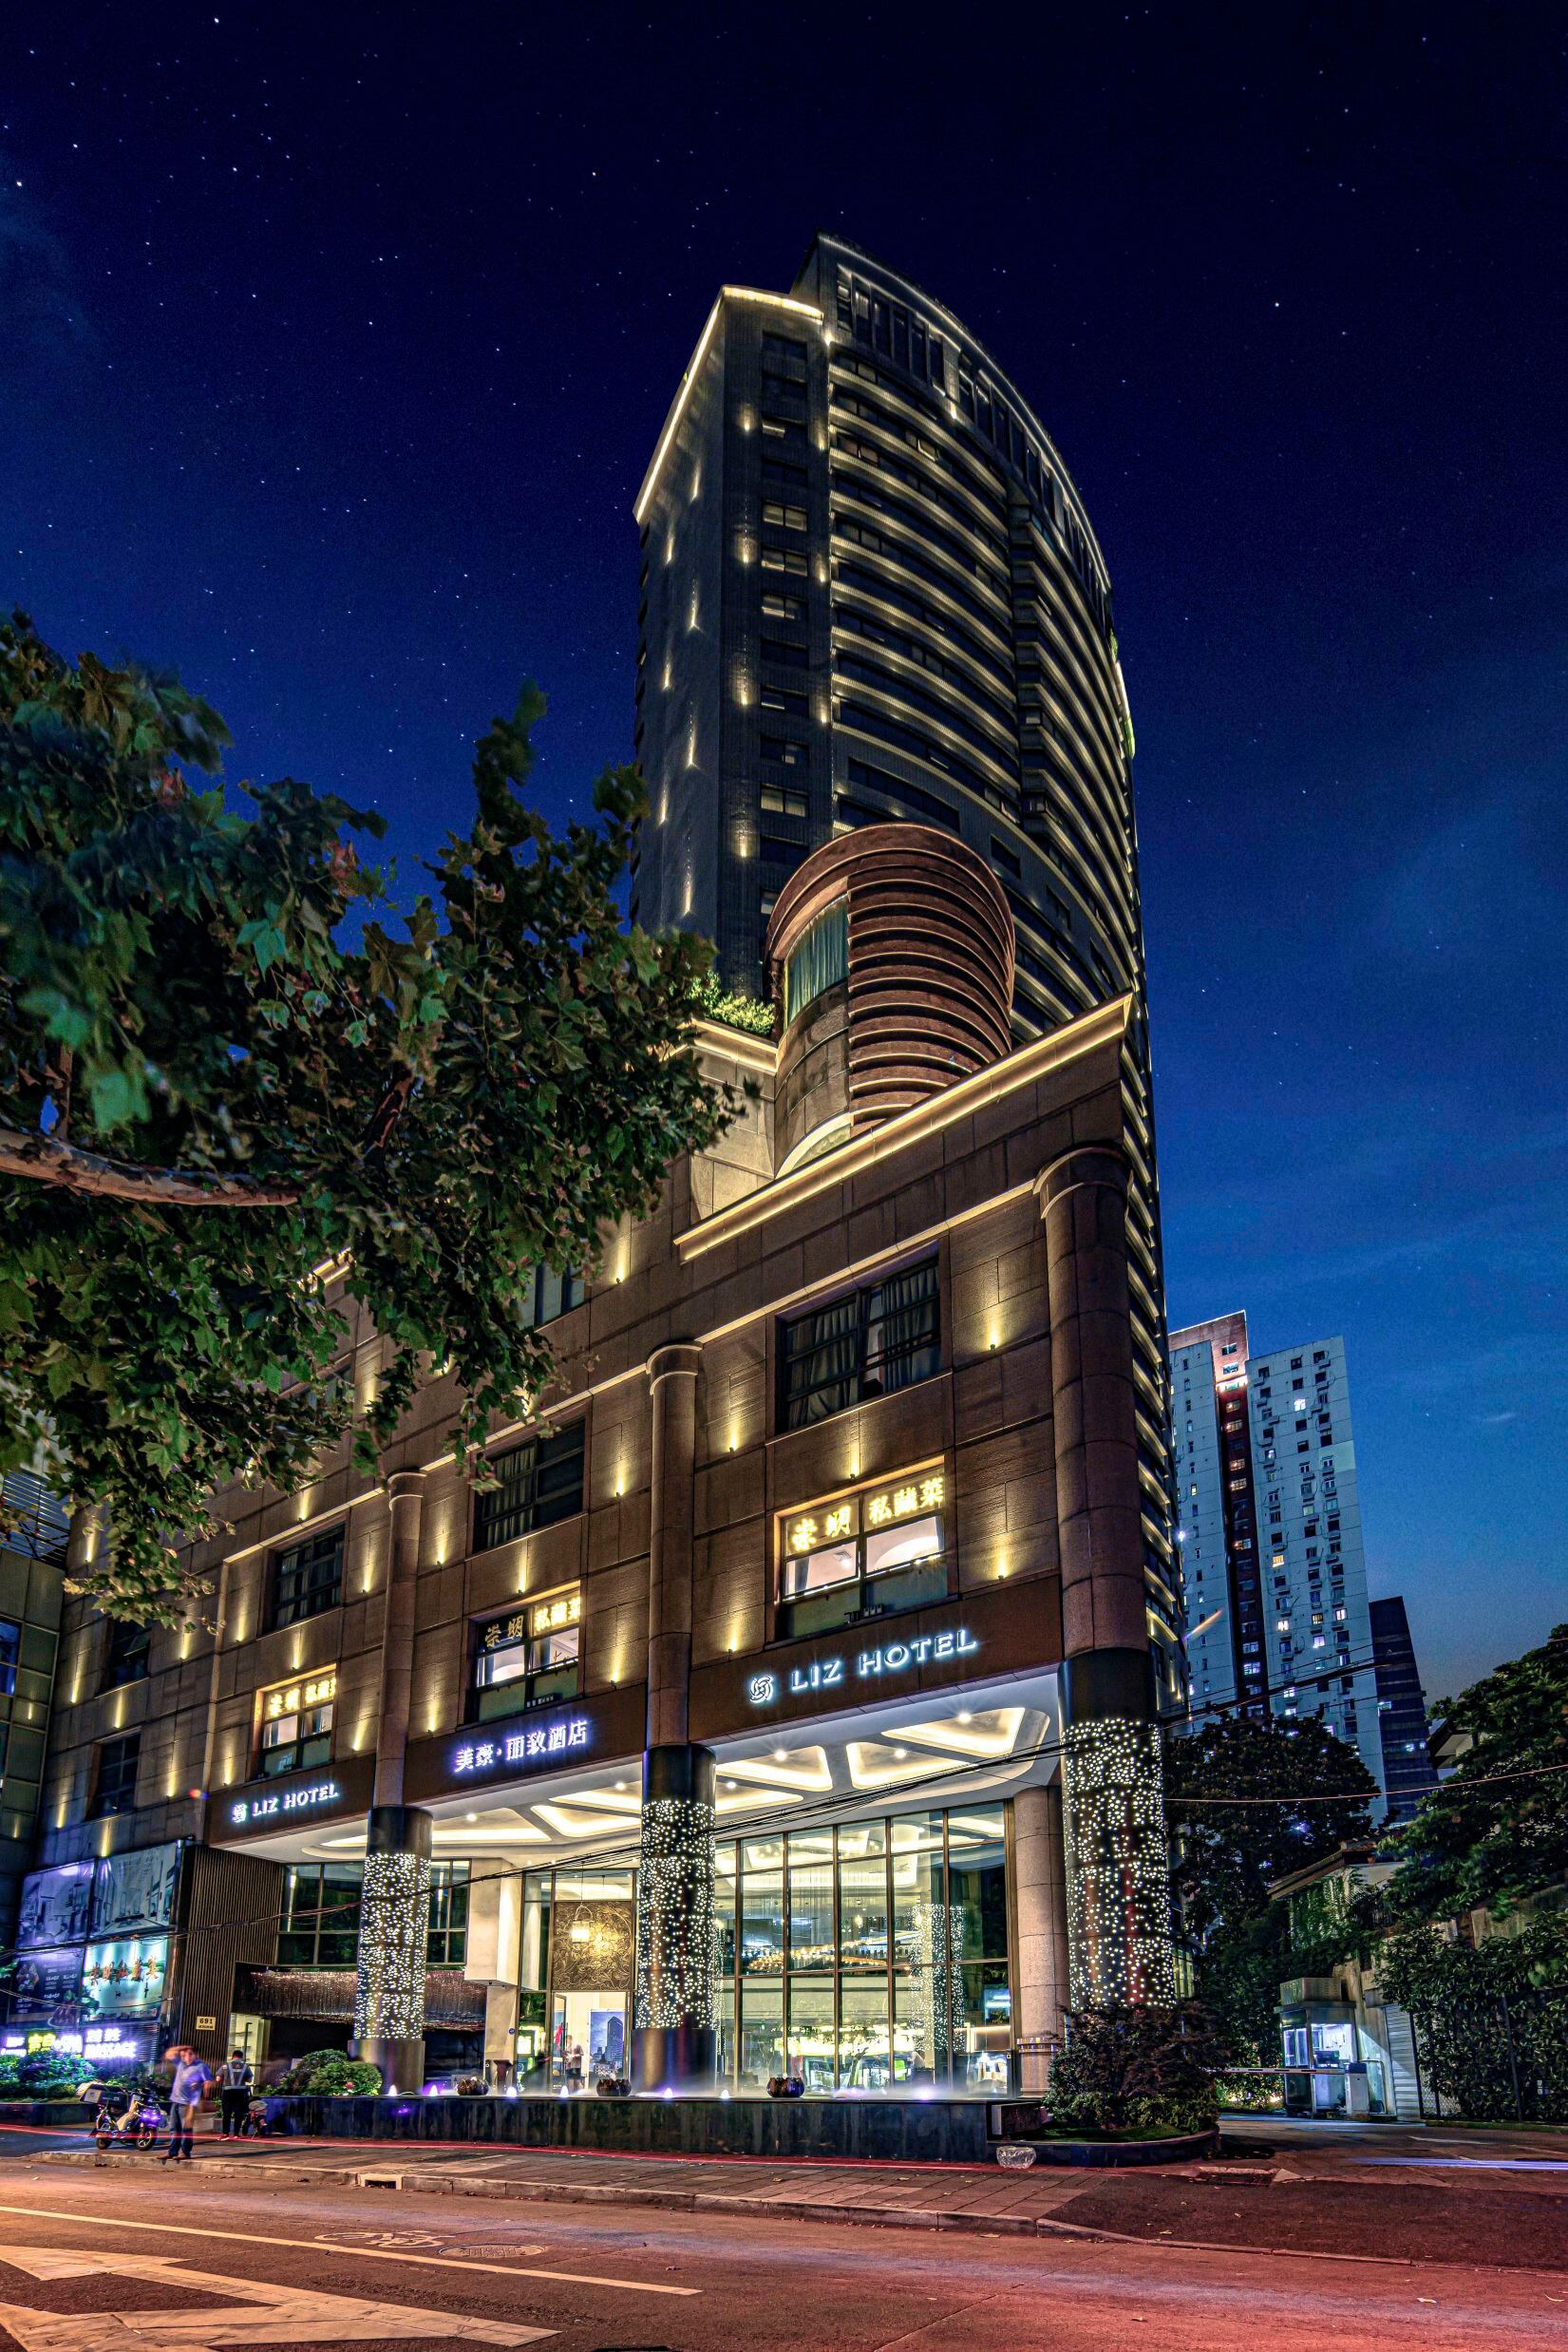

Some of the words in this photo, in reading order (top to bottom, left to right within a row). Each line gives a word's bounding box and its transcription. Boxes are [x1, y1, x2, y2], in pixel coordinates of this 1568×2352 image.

[791, 1660, 841, 1691] LIZ
[860, 1629, 977, 1676] HOTEL
[252, 1796, 278, 1816] LIZ
[283, 1783, 339, 1810] HOTEL
